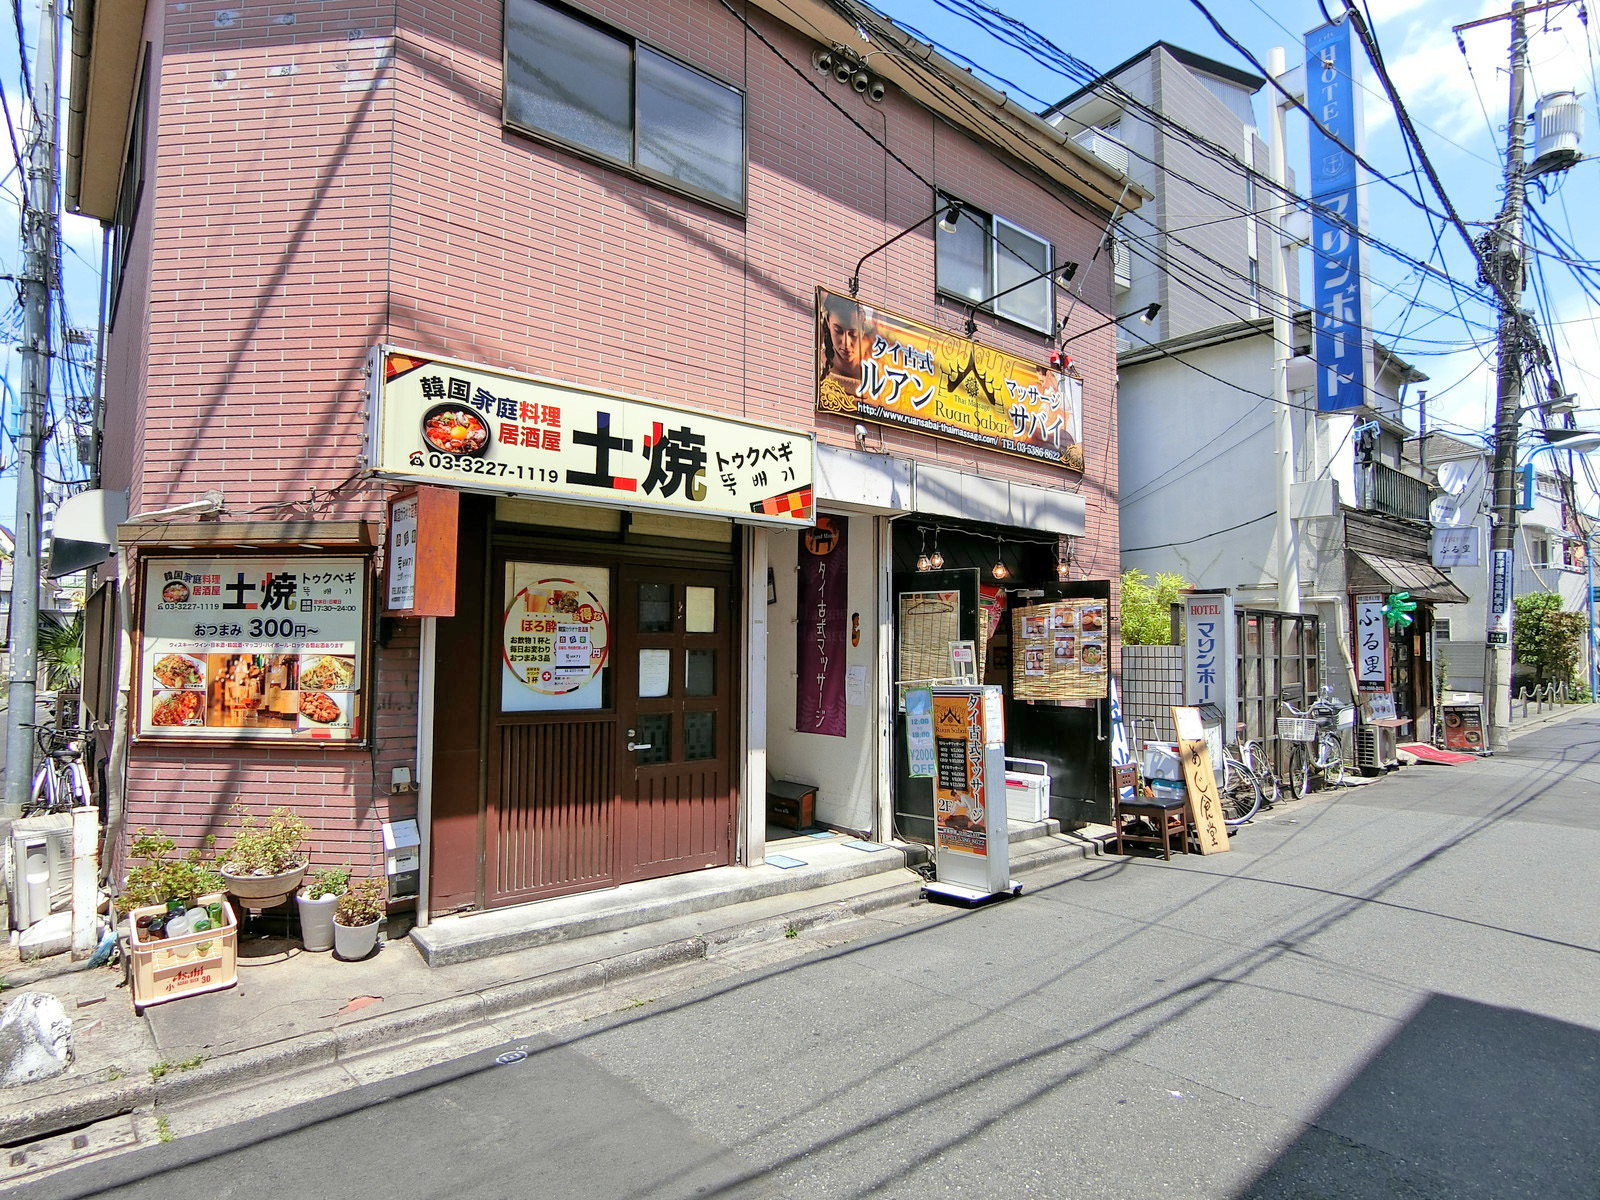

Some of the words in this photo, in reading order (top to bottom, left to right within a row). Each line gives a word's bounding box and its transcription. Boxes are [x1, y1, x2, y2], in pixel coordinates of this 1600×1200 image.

[1320, 45, 1340, 141] HOTEL
[872, 335, 934, 375] タイ古式
[857, 359, 936, 410] ルアン
[1004, 378, 1061, 411] マッサージ
[419, 375, 561, 428] 韓国家庭料理
[954, 394, 967, 405] Thai
[968, 397, 990, 412] Massage
[934, 400, 971, 425] Ruan
[974, 410, 1008, 434] Sabai
[1008, 404, 1063, 449] サバイ
[498, 423, 561, 452] 居酒屋
[1001, 438, 1016, 452] TEL
[428, 452, 558, 483] 03-3227-1119
[566, 411, 707, 501] 土焼
[715, 441, 792, 471] トゥクペギ
[163, 570, 221, 585] 韓国家庭料理
[192, 585, 221, 596] 居酒屋
[223, 572, 297, 610] 土焼
[302, 572, 356, 584] トゥクペギ
[1190, 604, 1221, 615] HOTEL
[194, 623, 242, 637] おつまみ
[816, 561, 828, 728] タイ古式マッサージ
[1359, 608, 1382, 676] ふる里
[510, 645, 550, 653] 毎日お変わり
[1196, 622, 1216, 703] マリンポー
[912, 764, 935, 774] OFF
[967, 693, 983, 823] タイ古式マッサージ
[938, 798, 952, 812] 2F
[166, 983, 175, 991] 小
[172, 965, 204, 982] Asahi
[202, 975, 211, 983] 30
